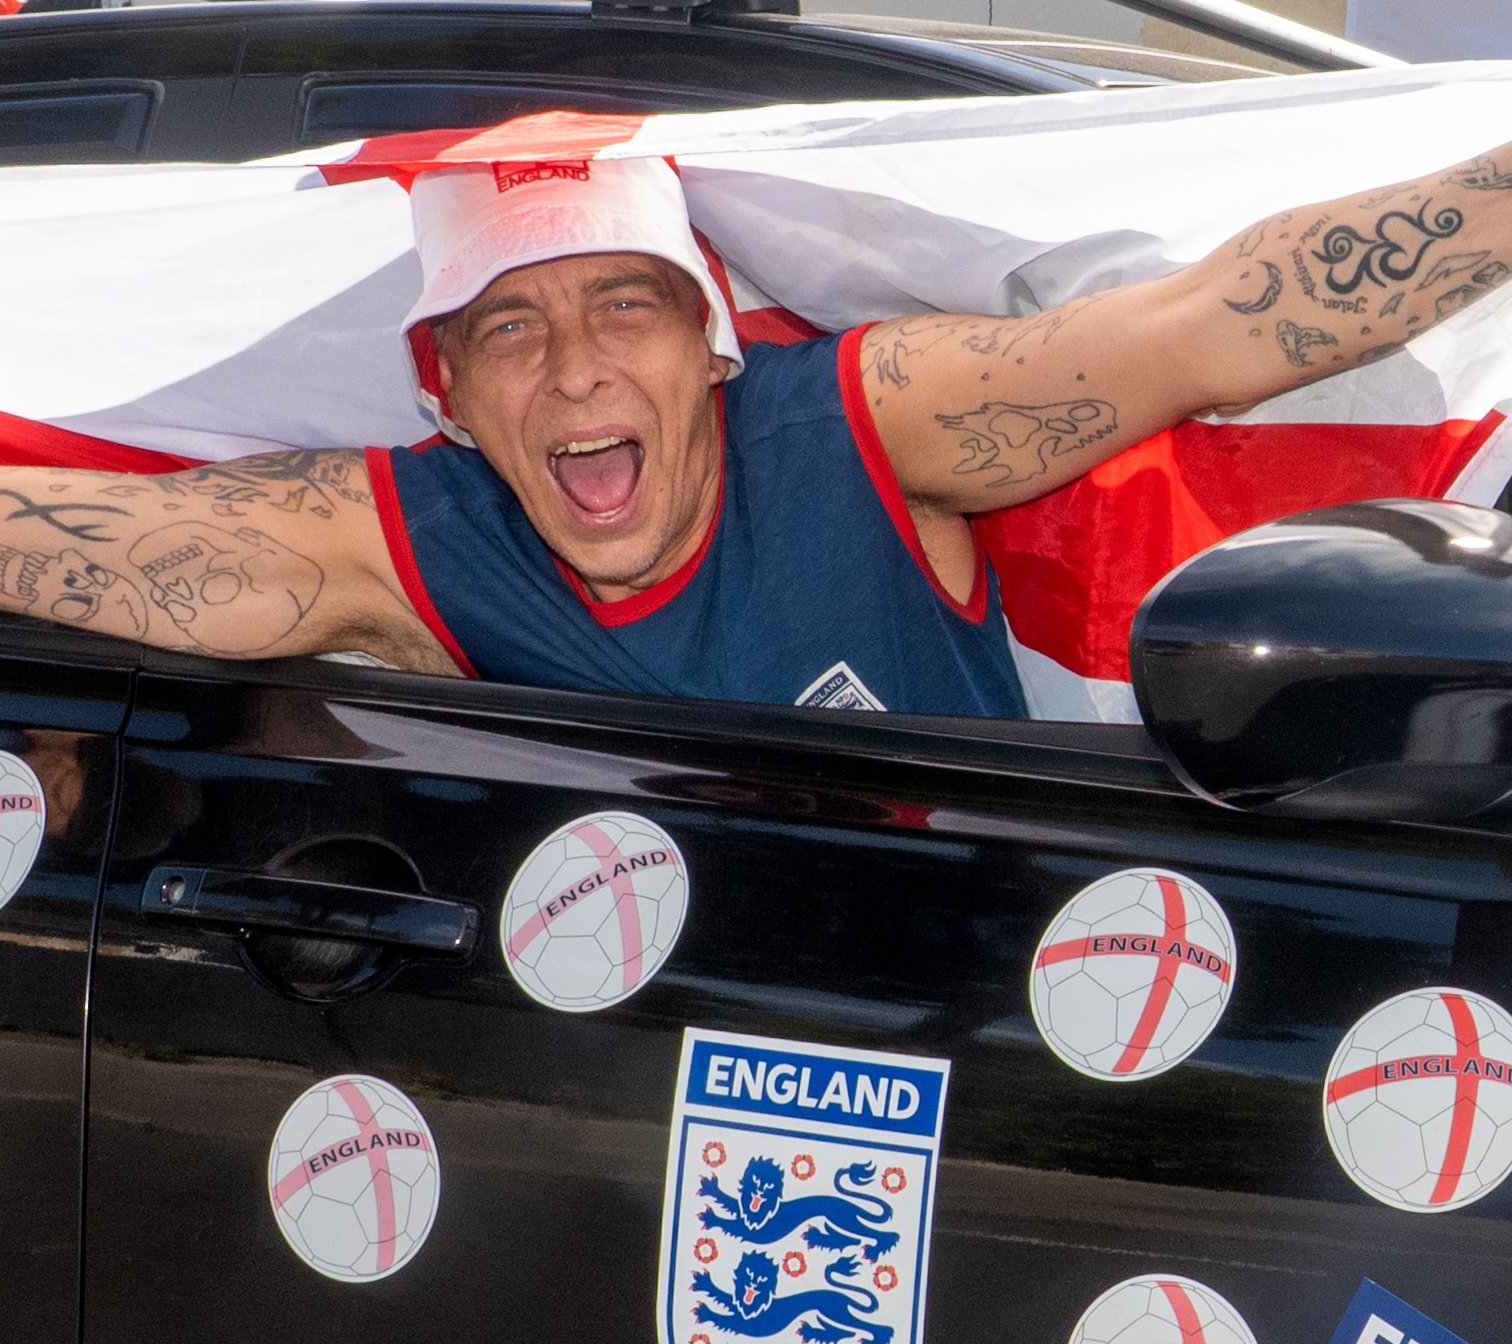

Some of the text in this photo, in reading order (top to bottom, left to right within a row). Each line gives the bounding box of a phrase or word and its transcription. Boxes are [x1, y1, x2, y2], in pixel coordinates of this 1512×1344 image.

[497, 168, 590, 193] ENGLAND
[806, 676, 845, 708] NGLAND
[545, 850, 668, 919] ENGLAND
[1093, 936, 1223, 974] ENGLAND
[705, 1054, 920, 1121] ENGLAND
[308, 1129, 421, 1175] ENGLAND
